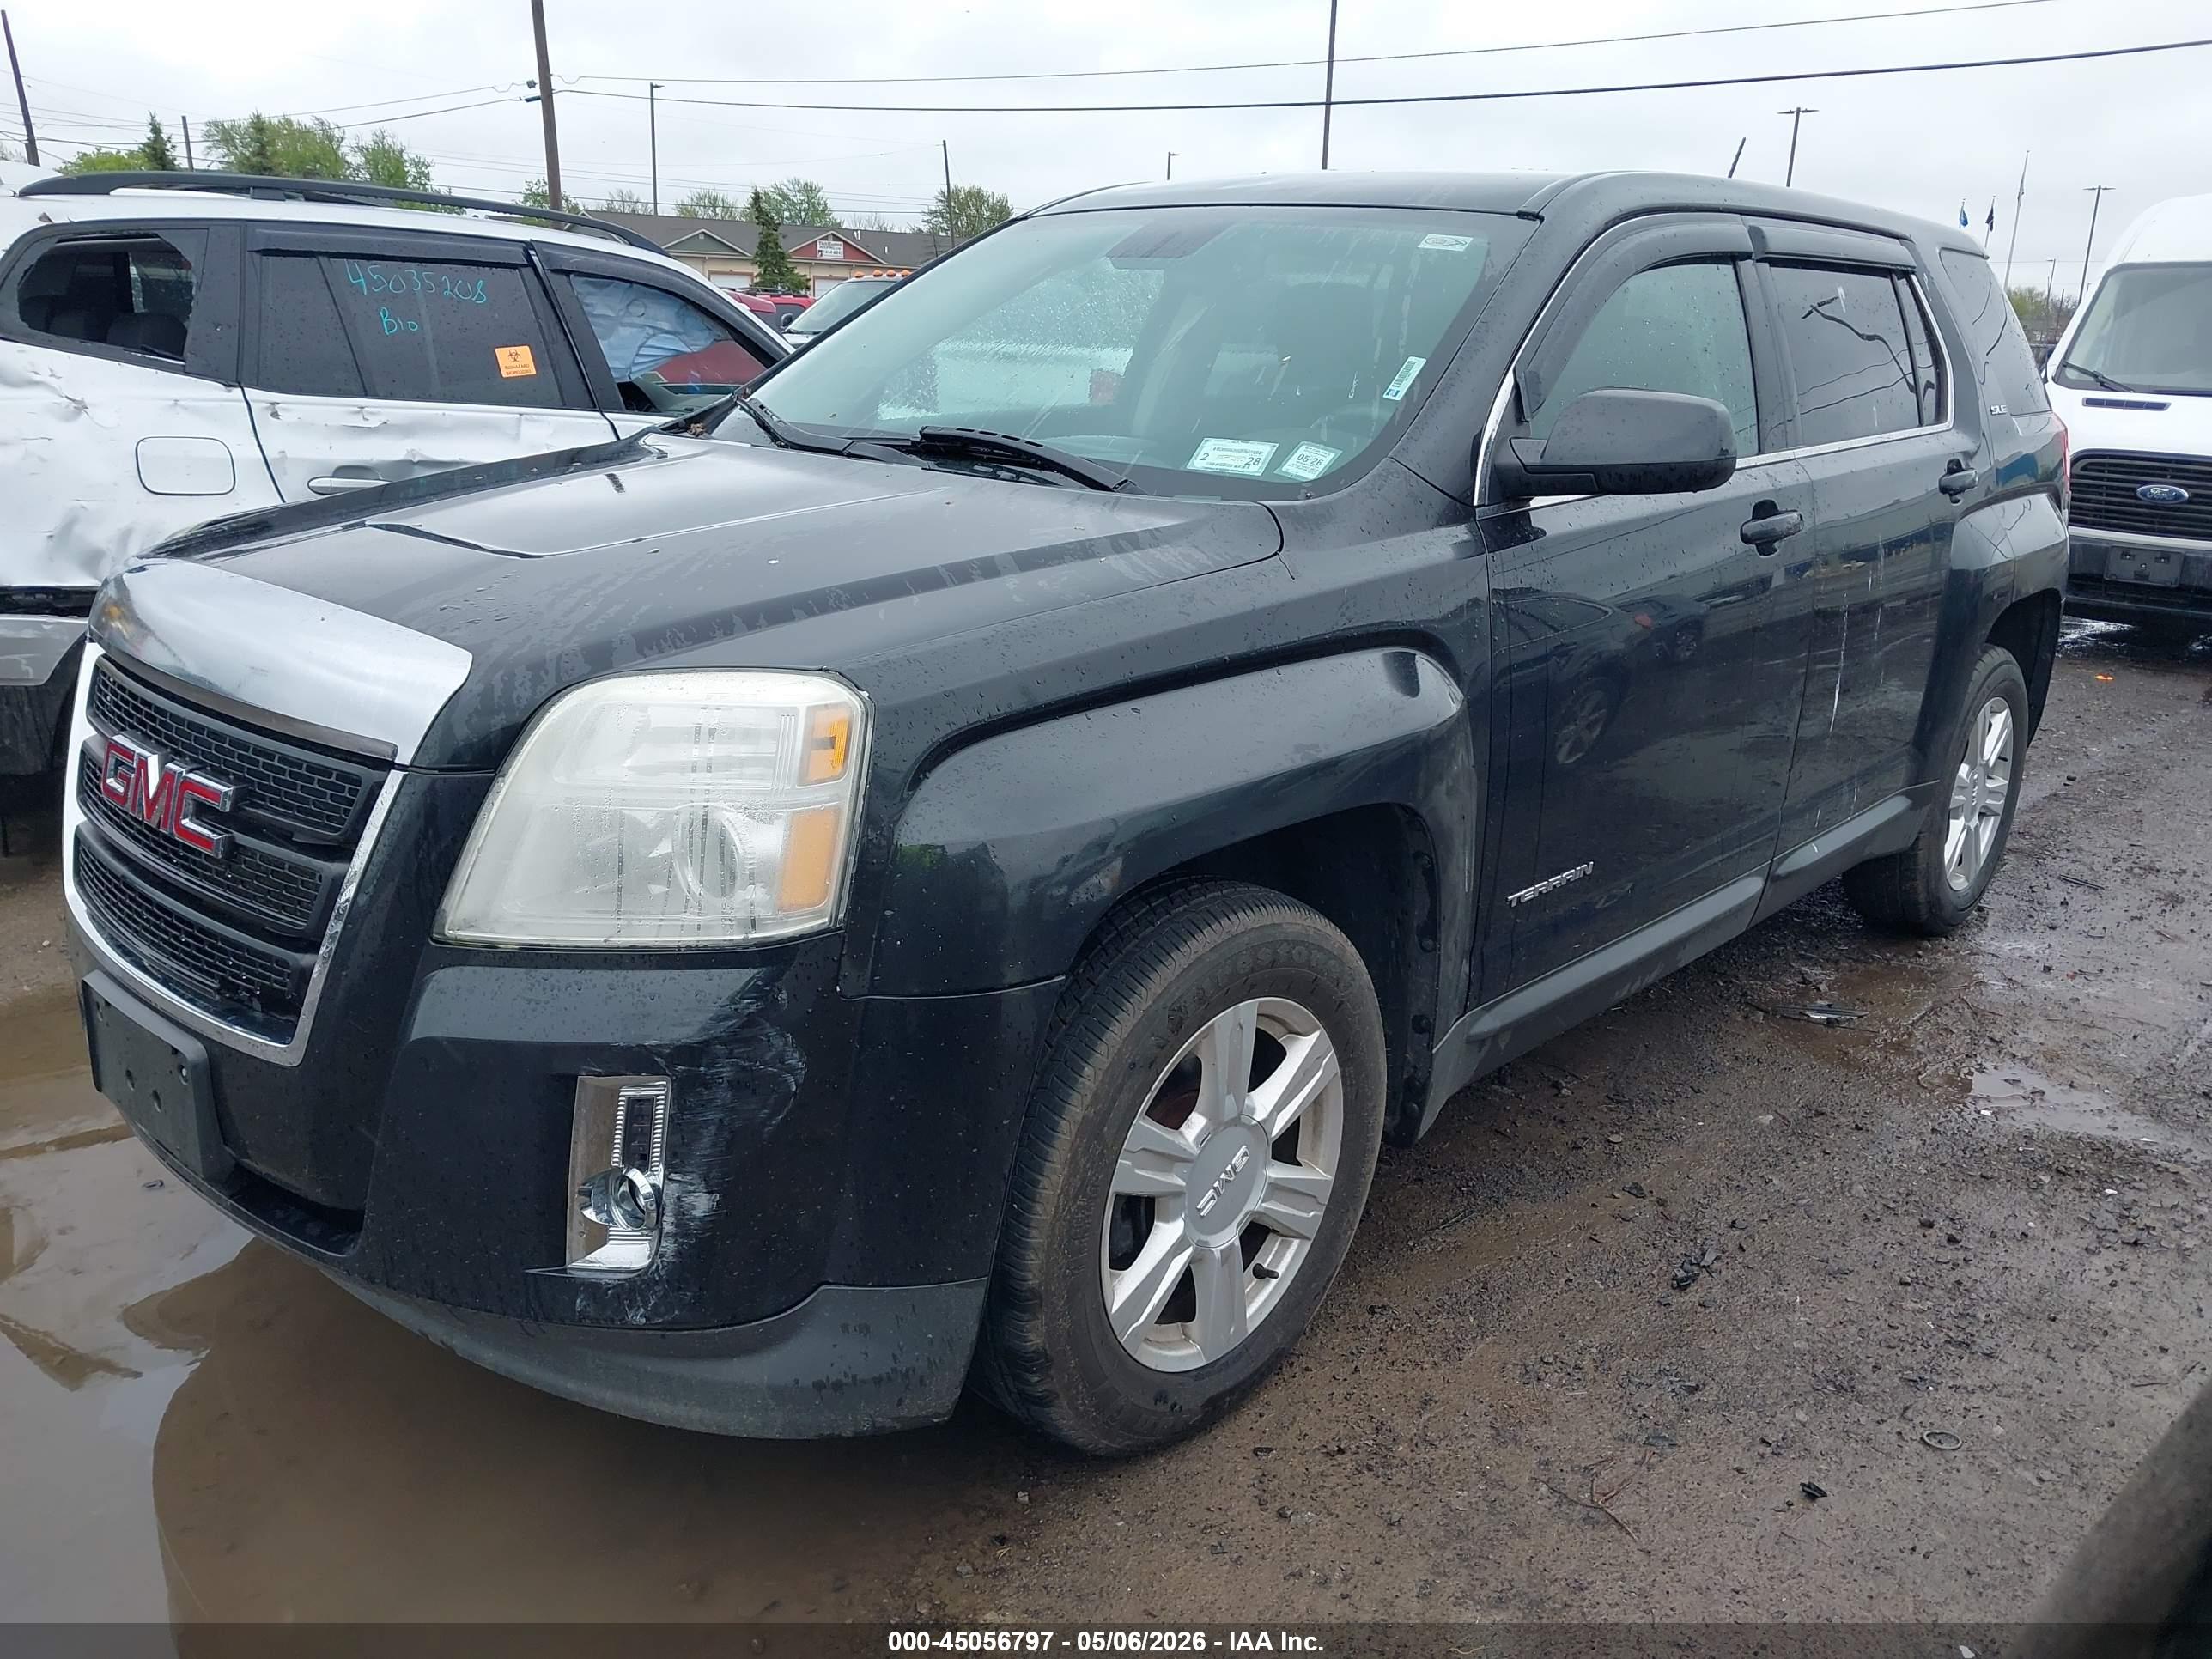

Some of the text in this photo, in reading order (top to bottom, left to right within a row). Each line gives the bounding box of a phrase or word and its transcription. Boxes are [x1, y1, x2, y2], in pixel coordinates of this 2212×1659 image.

[101, 735, 234, 859] GMC
[1507, 861, 1594, 908] TERRAIN
[1196, 1146, 1250, 1217] GMC
